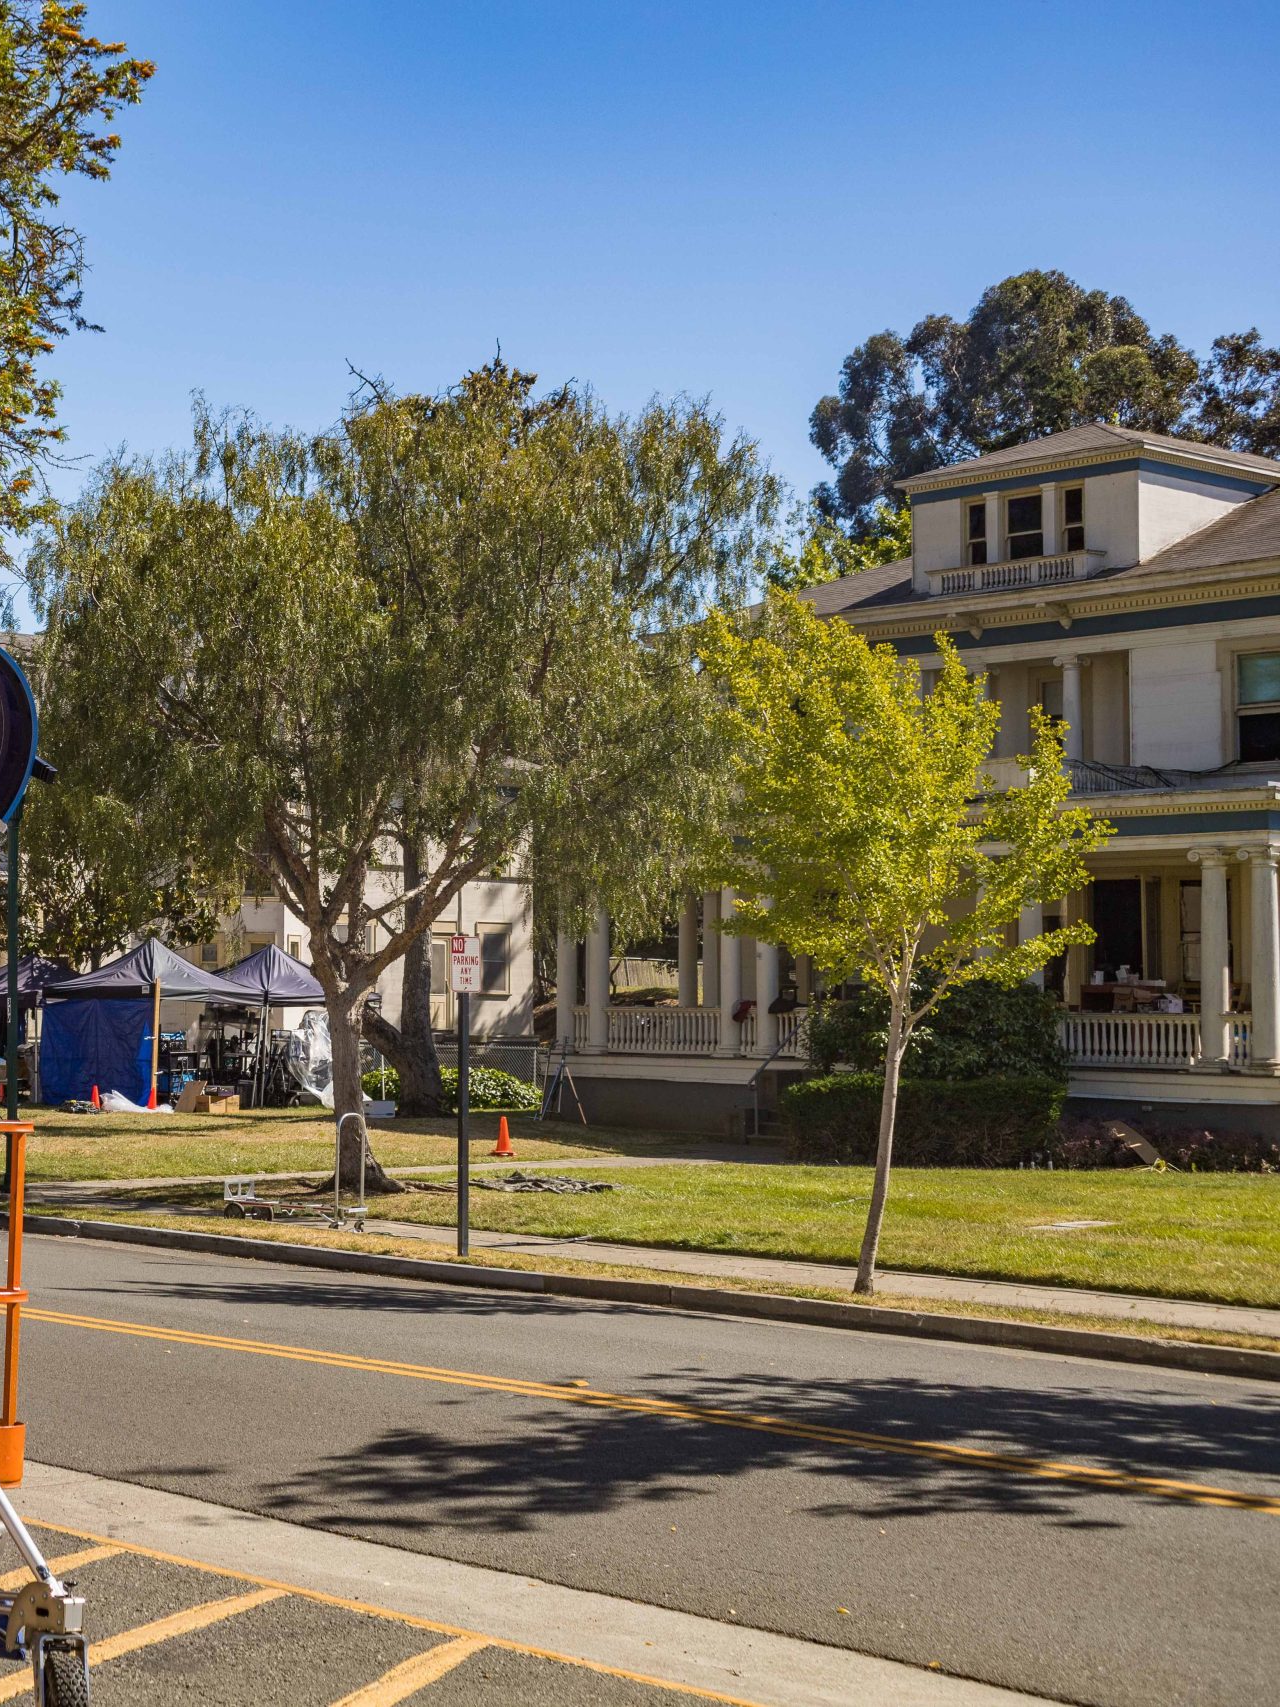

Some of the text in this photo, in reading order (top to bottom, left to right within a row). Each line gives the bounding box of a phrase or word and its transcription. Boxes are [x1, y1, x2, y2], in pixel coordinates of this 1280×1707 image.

[452, 938, 464, 952] NO
[453, 955, 478, 965] PARKING
[460, 967, 472, 975] ANY
[459, 977, 472, 985] TIME
